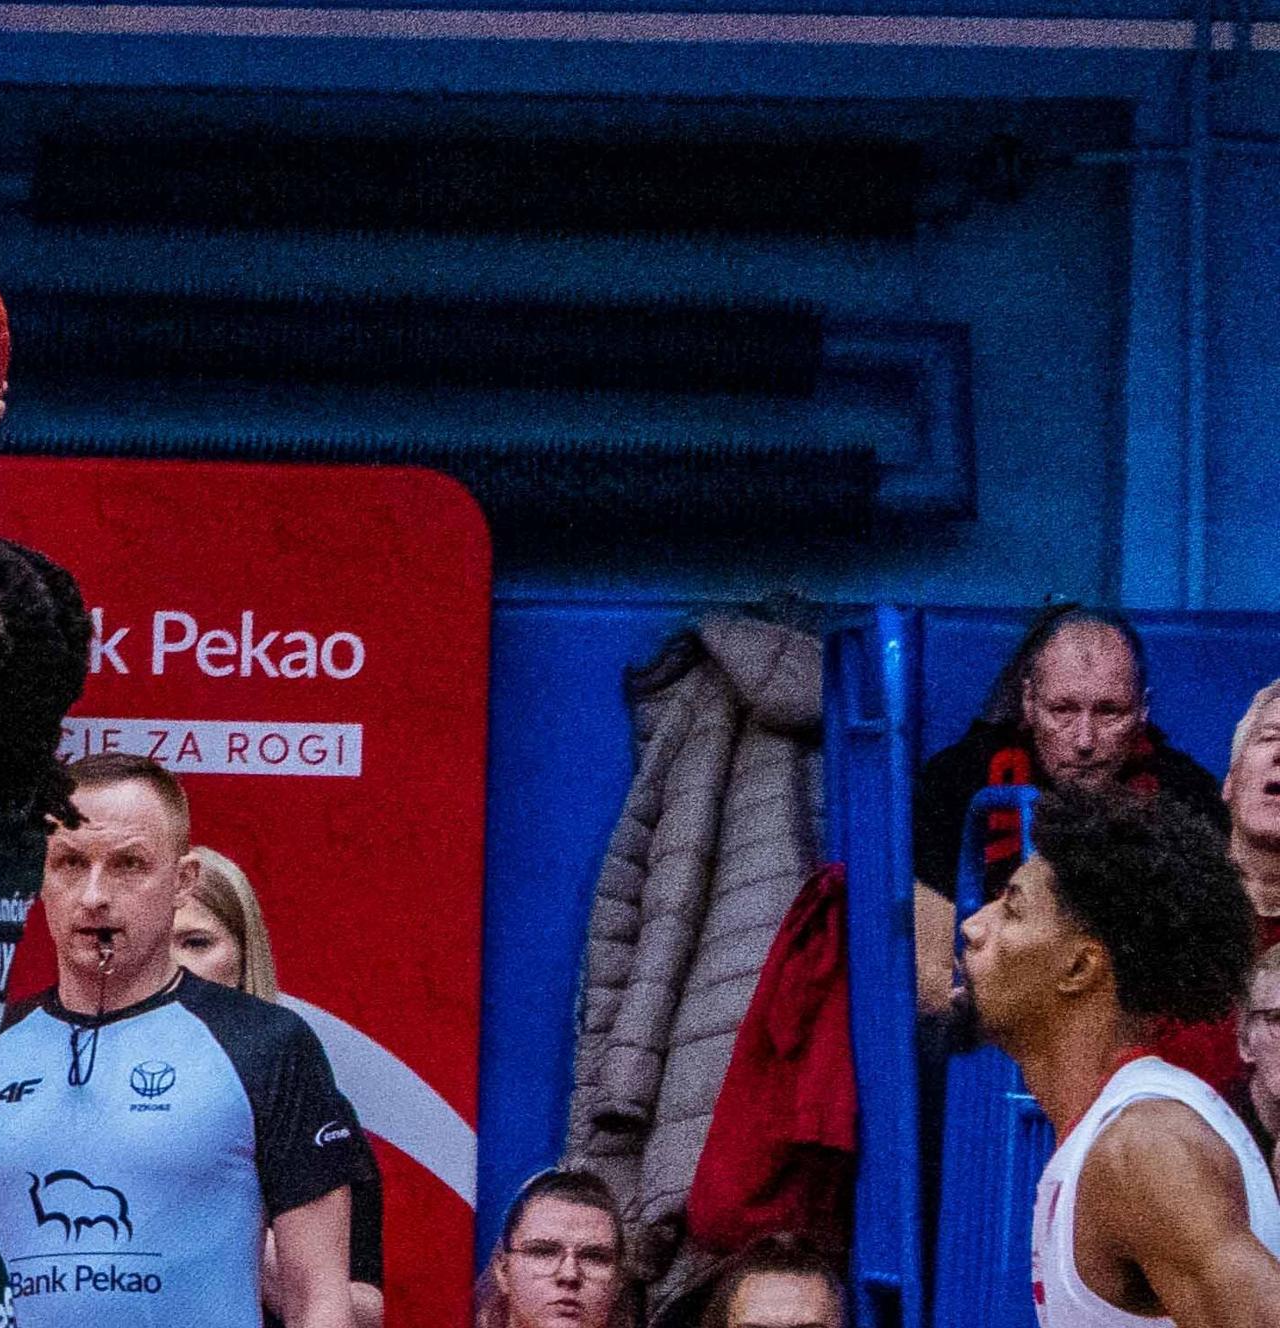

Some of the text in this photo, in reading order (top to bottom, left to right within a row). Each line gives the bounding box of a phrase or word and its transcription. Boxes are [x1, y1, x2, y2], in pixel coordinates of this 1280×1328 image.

[152, 609, 366, 681] Pekao
[146, 730, 203, 763] ZA
[227, 732, 345, 766] ROGI
[9, 1264, 162, 1299] Bank Pekao
